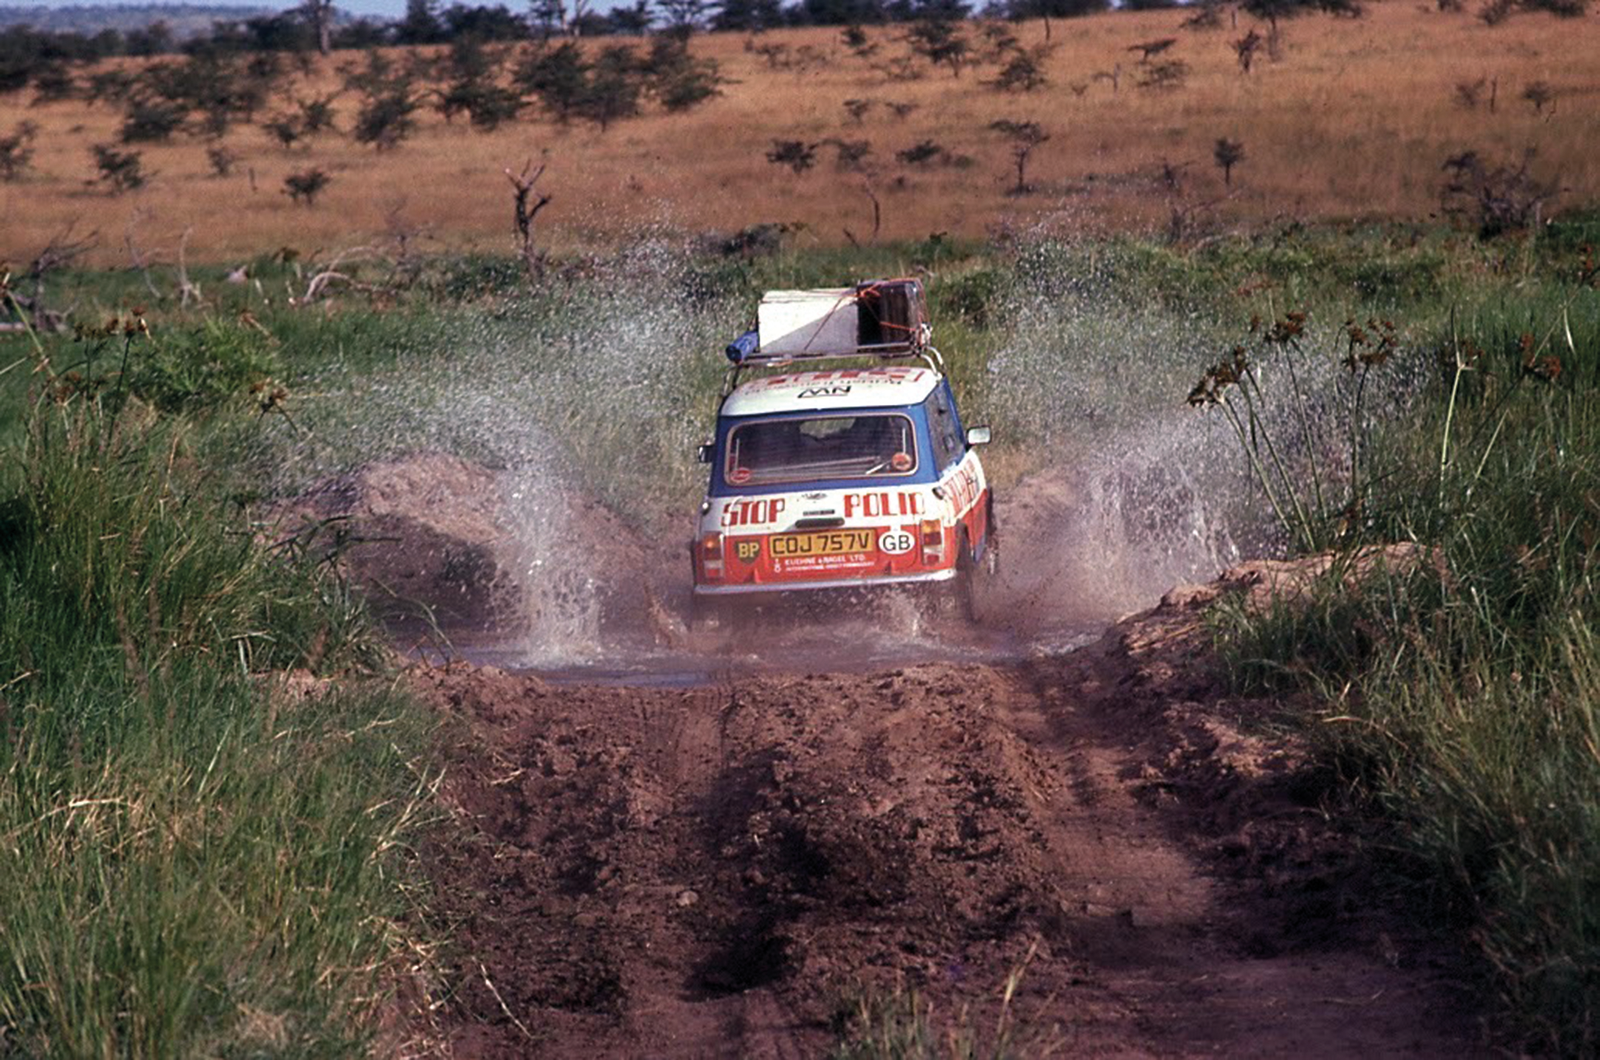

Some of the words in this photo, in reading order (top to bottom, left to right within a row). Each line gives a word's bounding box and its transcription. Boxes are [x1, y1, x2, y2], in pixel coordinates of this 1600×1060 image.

[721, 498, 785, 527] STOP
[844, 491, 926, 518] POLIO
[738, 542, 760, 558] BP
[772, 536, 812, 555] COJ
[817, 532, 870, 552] 757V
[882, 534, 911, 551] GB
